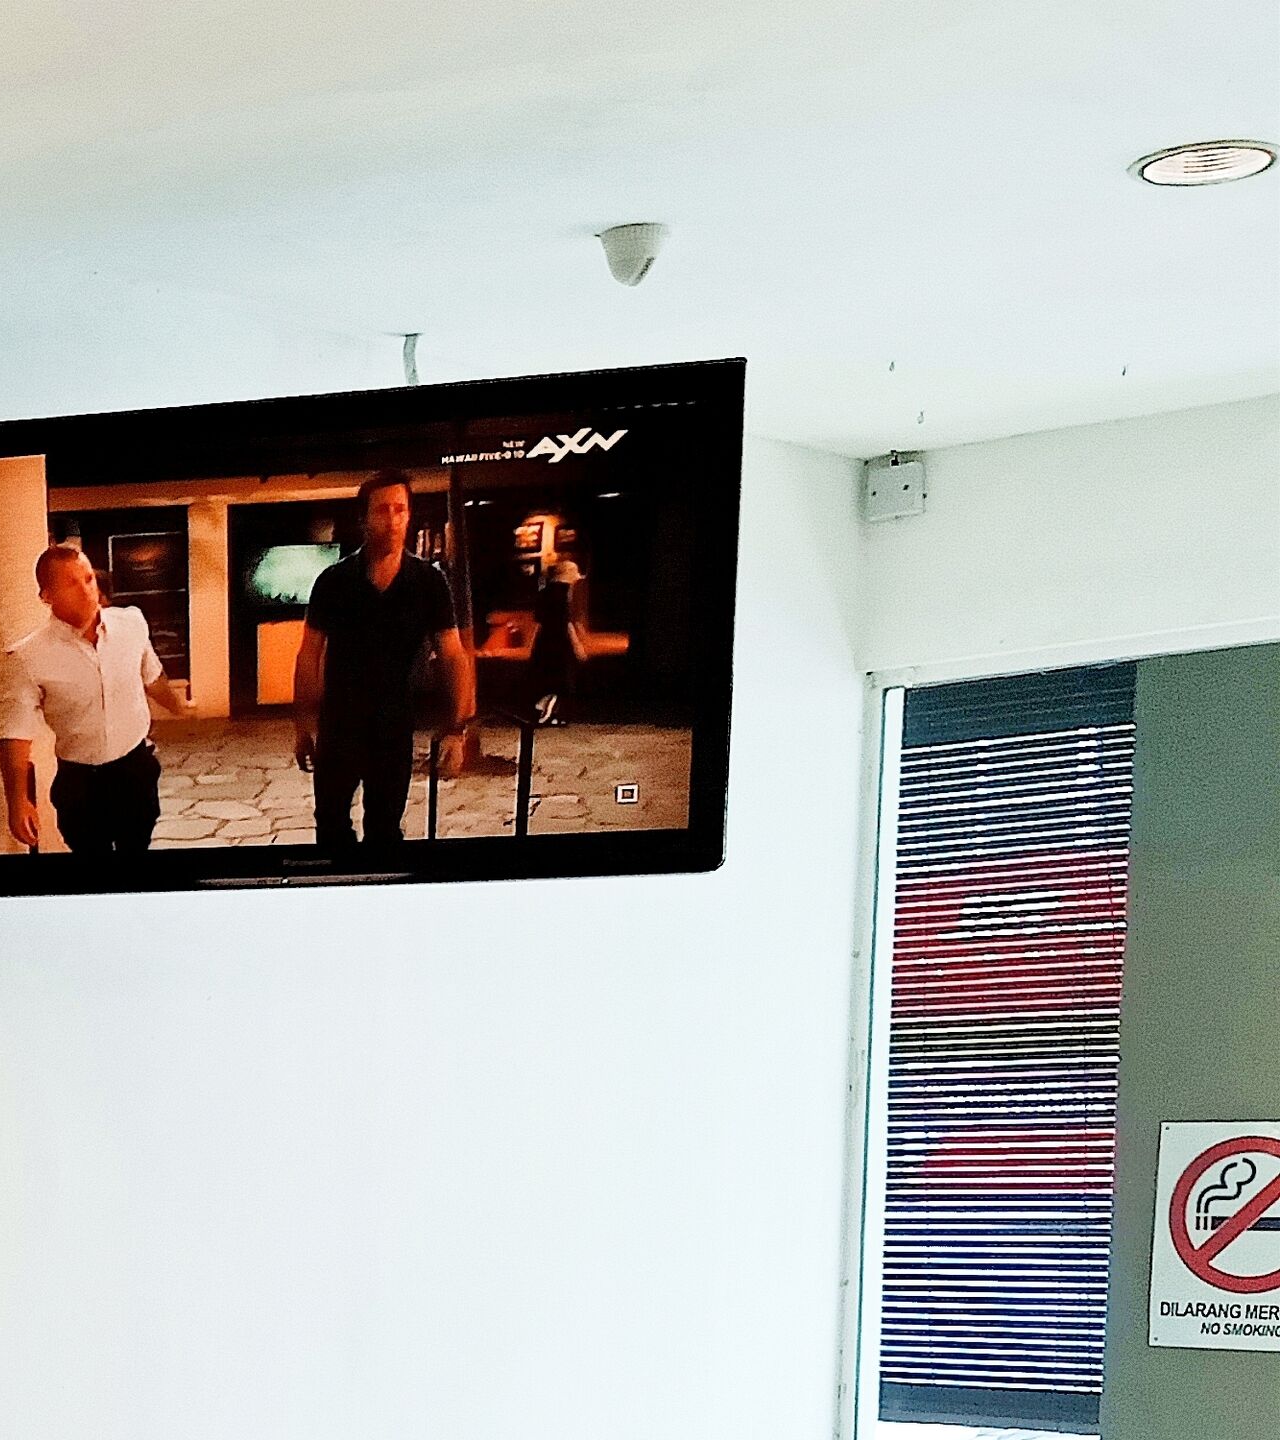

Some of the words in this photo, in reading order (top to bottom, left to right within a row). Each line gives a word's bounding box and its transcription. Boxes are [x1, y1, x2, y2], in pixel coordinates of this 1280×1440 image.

[526, 427, 629, 464] AXN
[1160, 1301, 1242, 1319] DILARANG
[1200, 1322, 1221, 1336] NO
